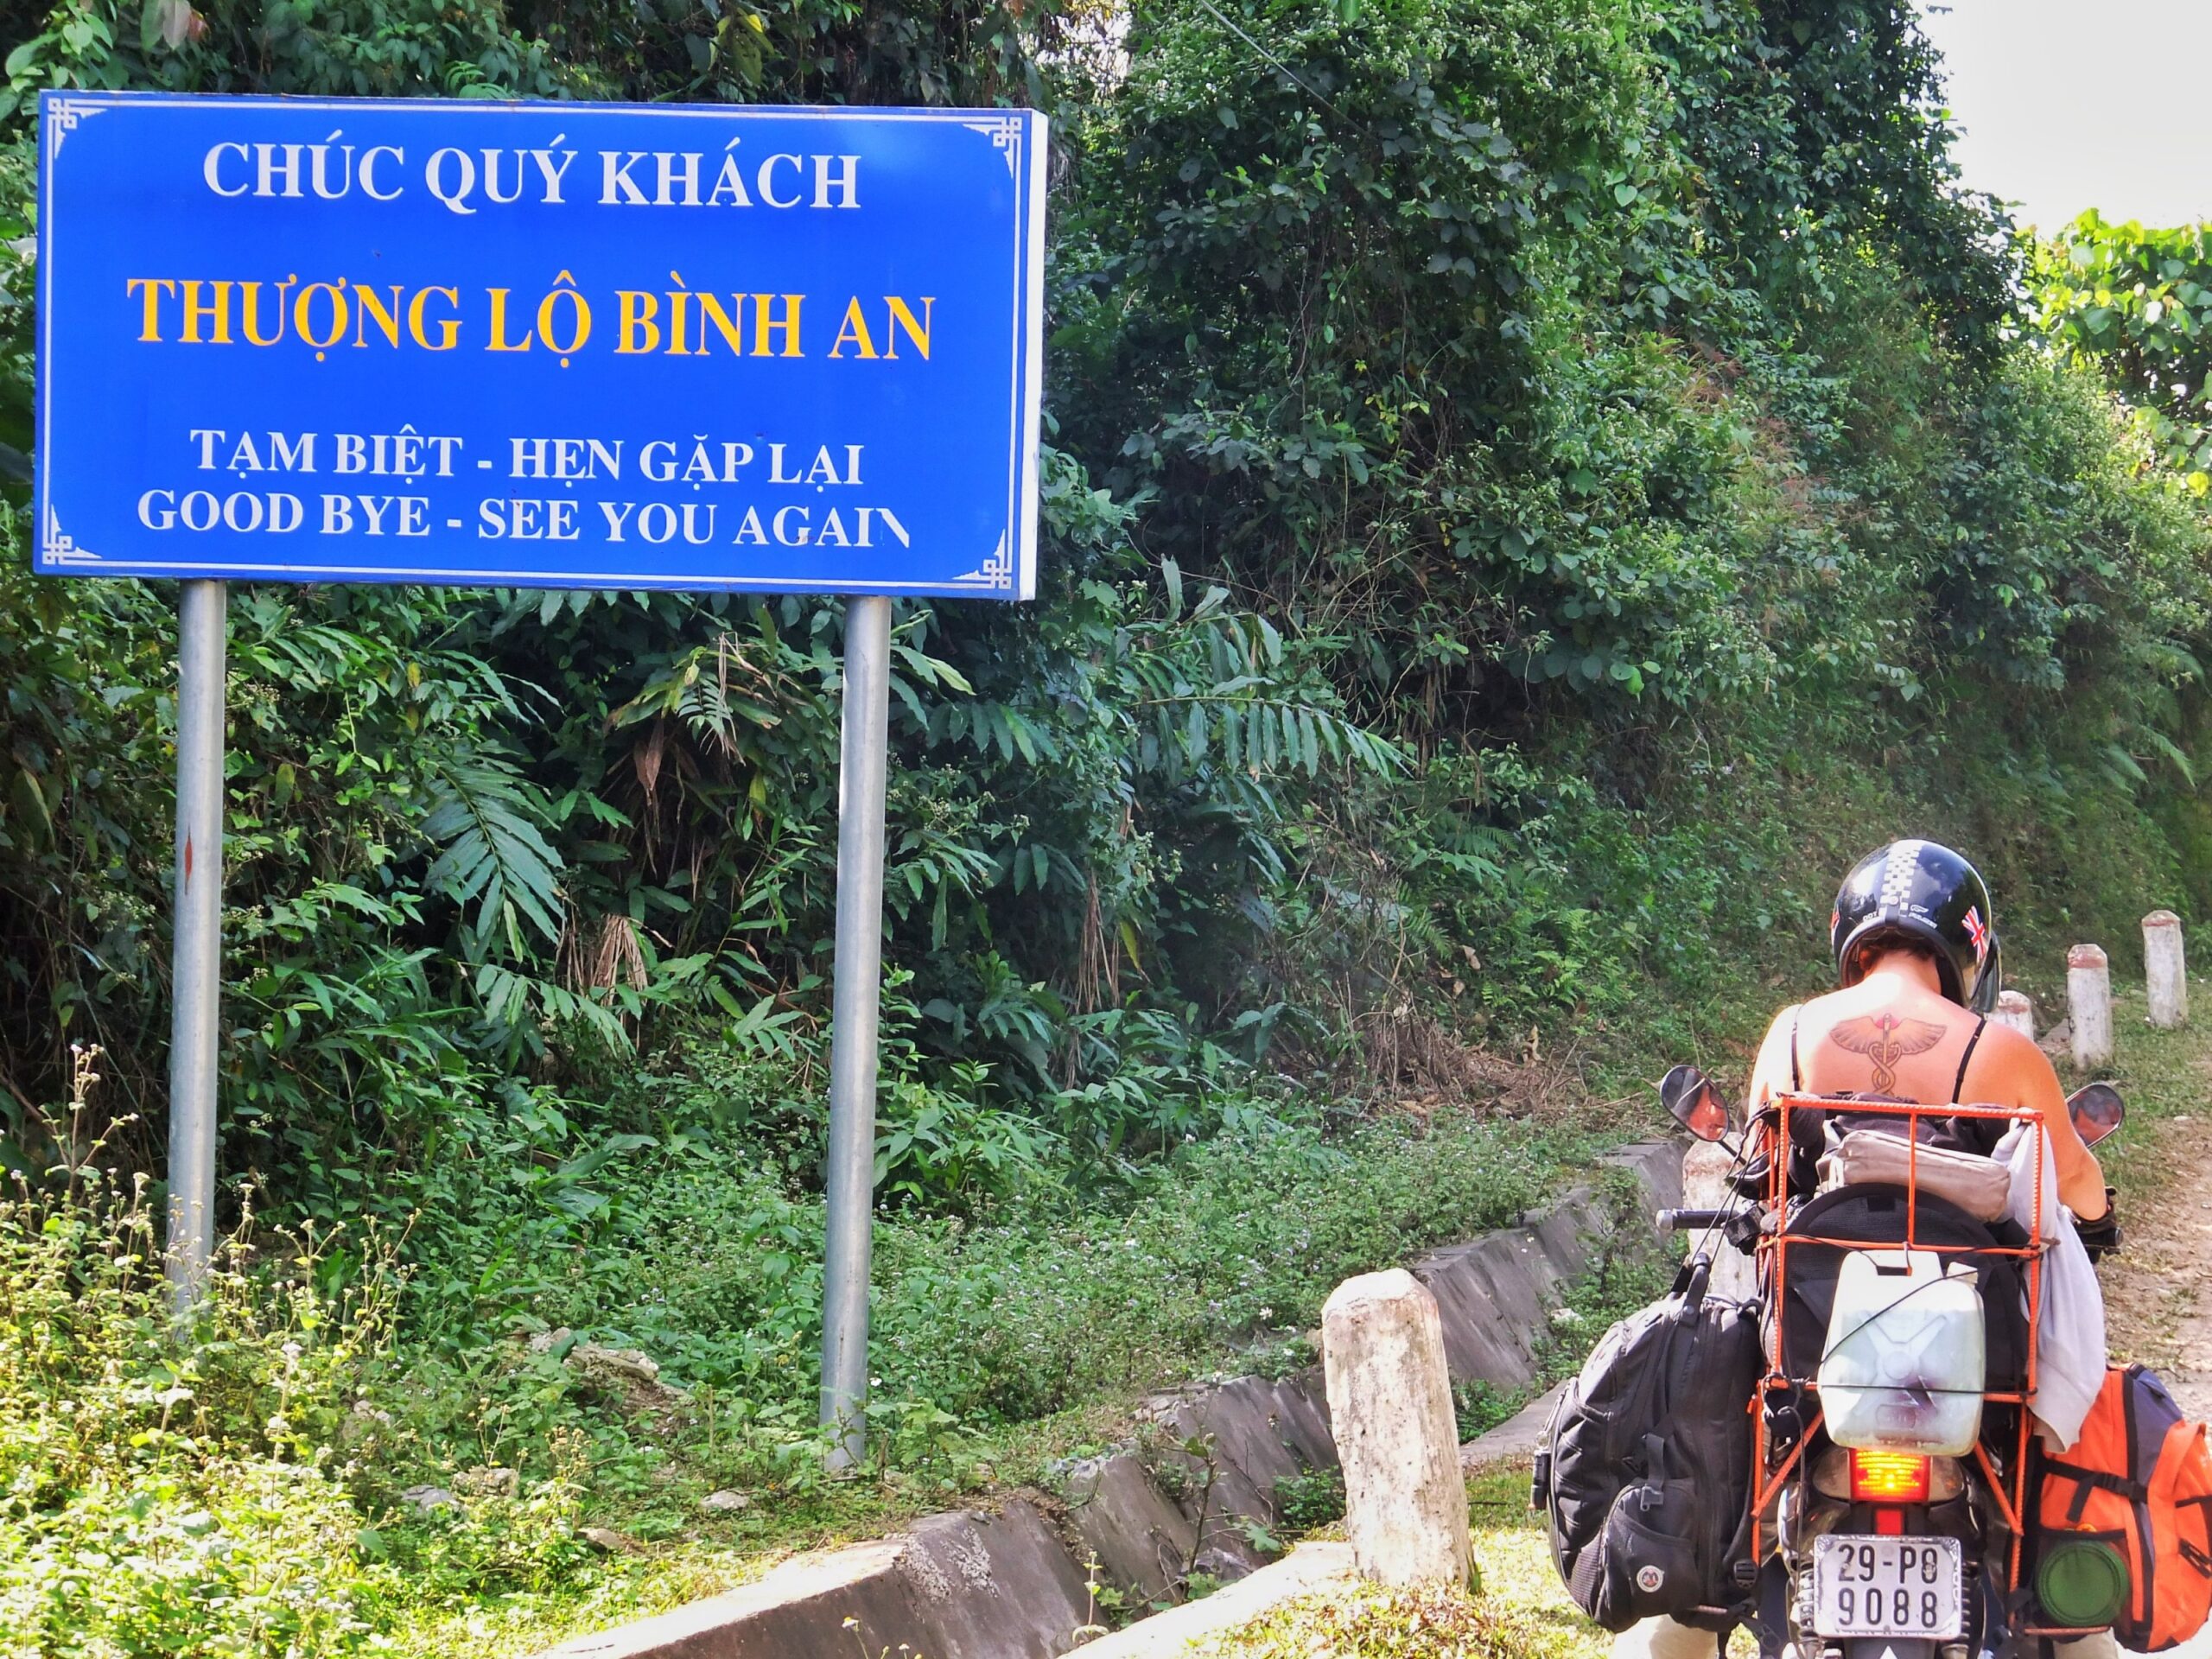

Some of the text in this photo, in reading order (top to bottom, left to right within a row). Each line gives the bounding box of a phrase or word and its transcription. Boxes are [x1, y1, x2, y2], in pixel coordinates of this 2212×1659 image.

[204, 129, 862, 215] CHÚC QUÝ KHÁCH
[126, 269, 936, 369] THƯỢNG LỘ BÌNH AN
[190, 423, 864, 493] TẠM BIỆT - HẸN GẶP LẠI
[137, 489, 911, 549] GOOD BYE - SEE YOU AGAIN
[1839, 1587, 1937, 1628] 9088
